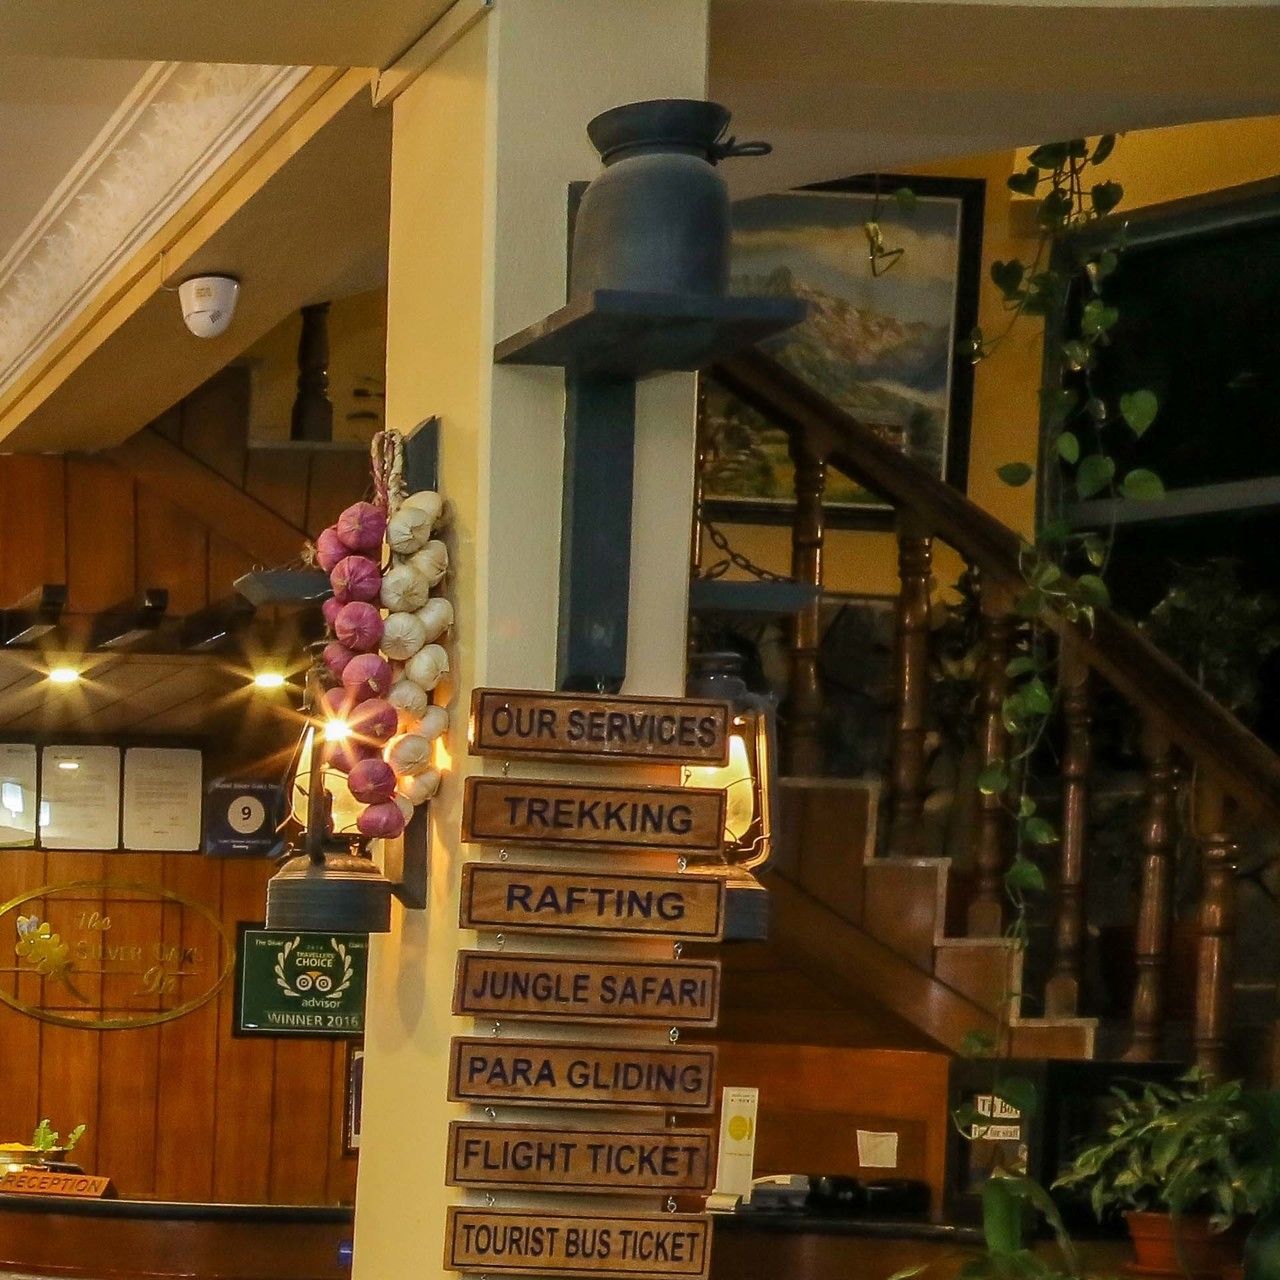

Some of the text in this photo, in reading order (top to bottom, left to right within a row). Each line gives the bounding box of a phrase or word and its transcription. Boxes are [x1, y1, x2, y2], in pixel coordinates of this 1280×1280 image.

[491, 706, 717, 748] OUR SERVICES
[241, 806, 252, 820] 9
[504, 796, 694, 835] TREKKING
[506, 883, 686, 921] RAFTING
[296, 958, 333, 967] CHOICE
[472, 969, 707, 1008] JUNGLE SAFARI
[268, 1012, 359, 1028] WINNER 2016
[468, 1056, 704, 1093] PARA GLIDING
[463, 1139, 701, 1177] FLIGHT TICKET
[3, 1175, 103, 1193] RECEPTION
[463, 1224, 700, 1263] TOURIST BUS TICKET
